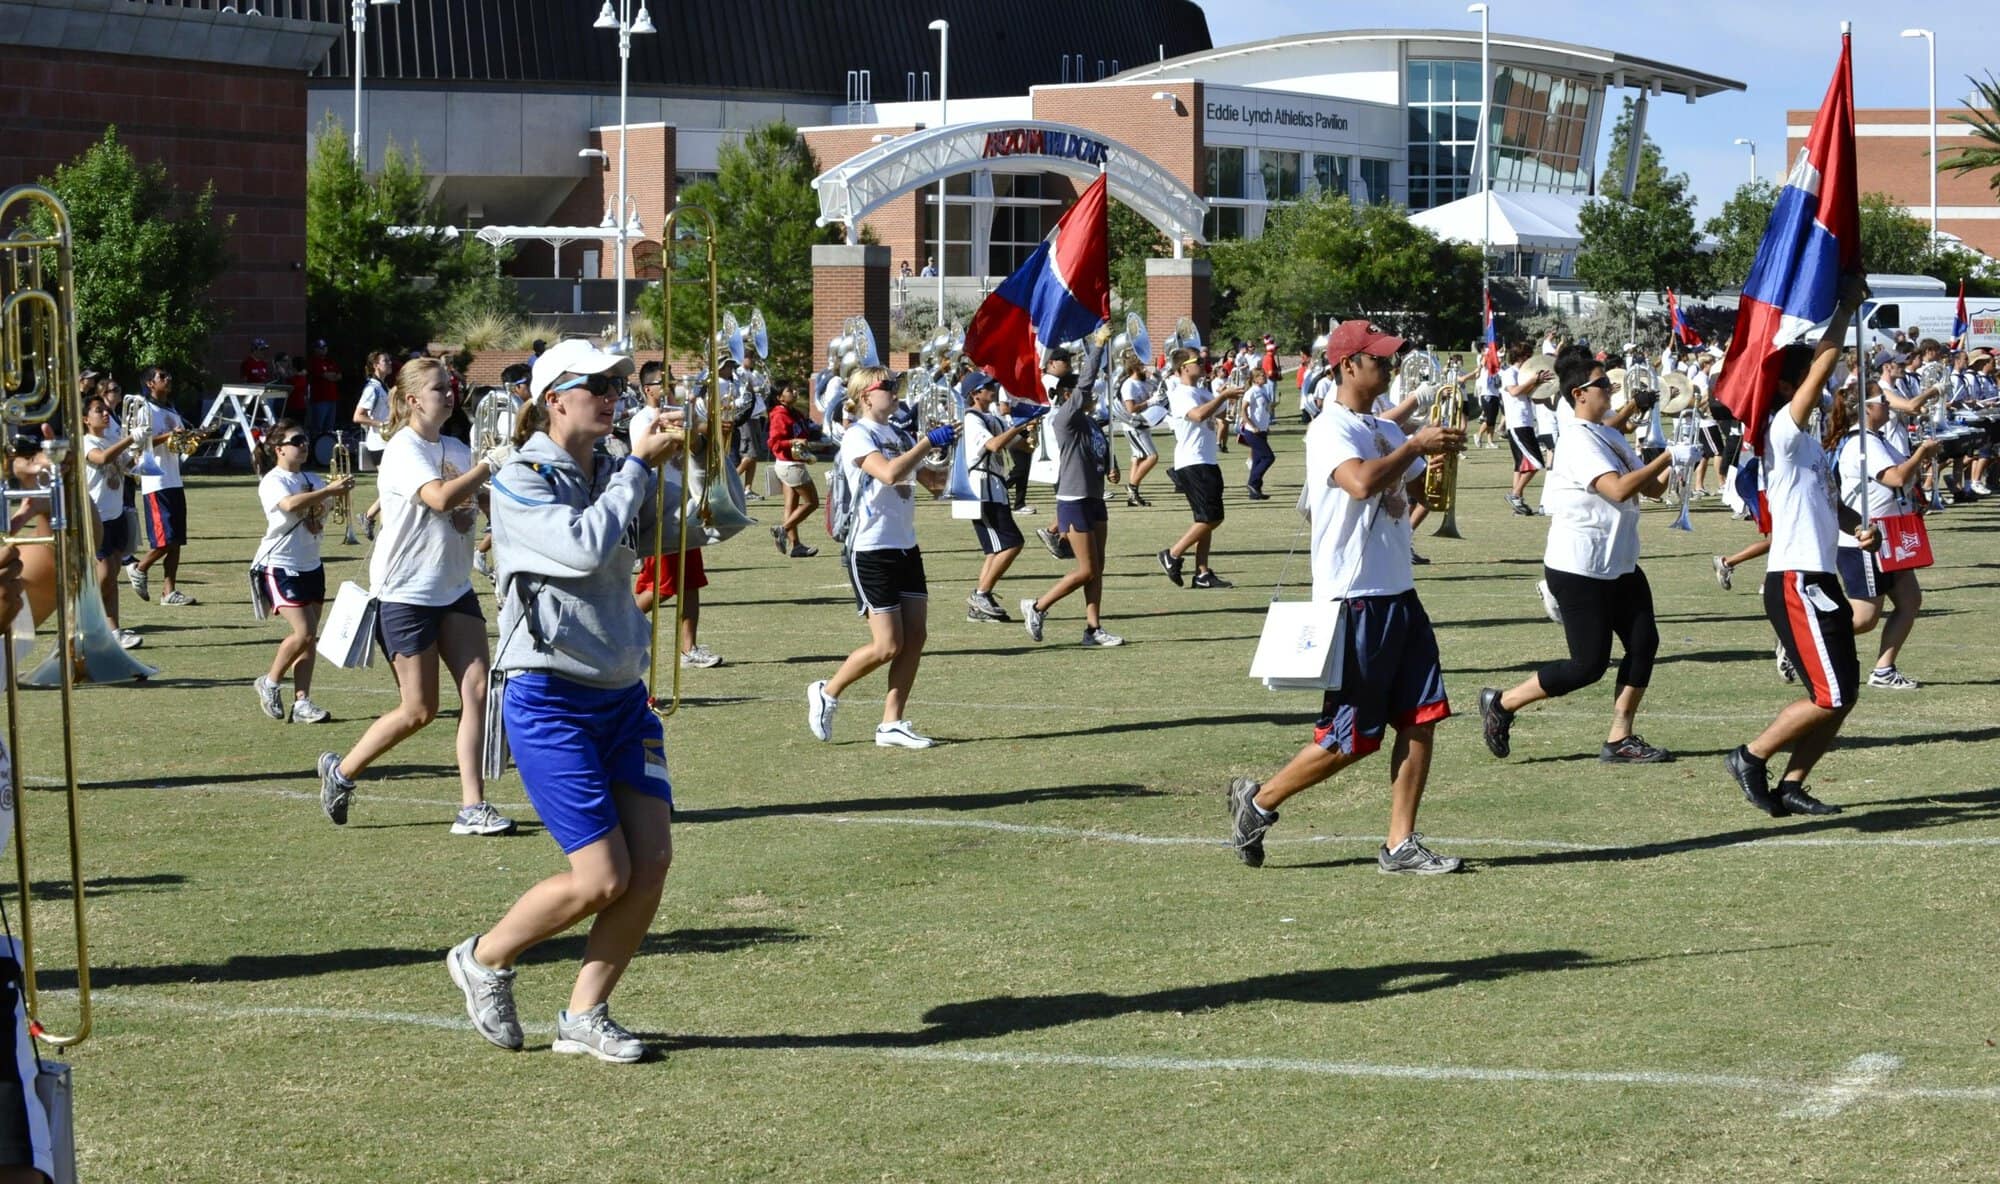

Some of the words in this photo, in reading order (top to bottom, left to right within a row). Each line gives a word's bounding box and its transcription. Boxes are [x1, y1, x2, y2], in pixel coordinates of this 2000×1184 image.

[1206, 103, 1239, 121] Eddie
[1242, 106, 1272, 126] Lynch
[1274, 108, 1313, 127] Athletics
[1315, 112, 1348, 131] Pavilion
